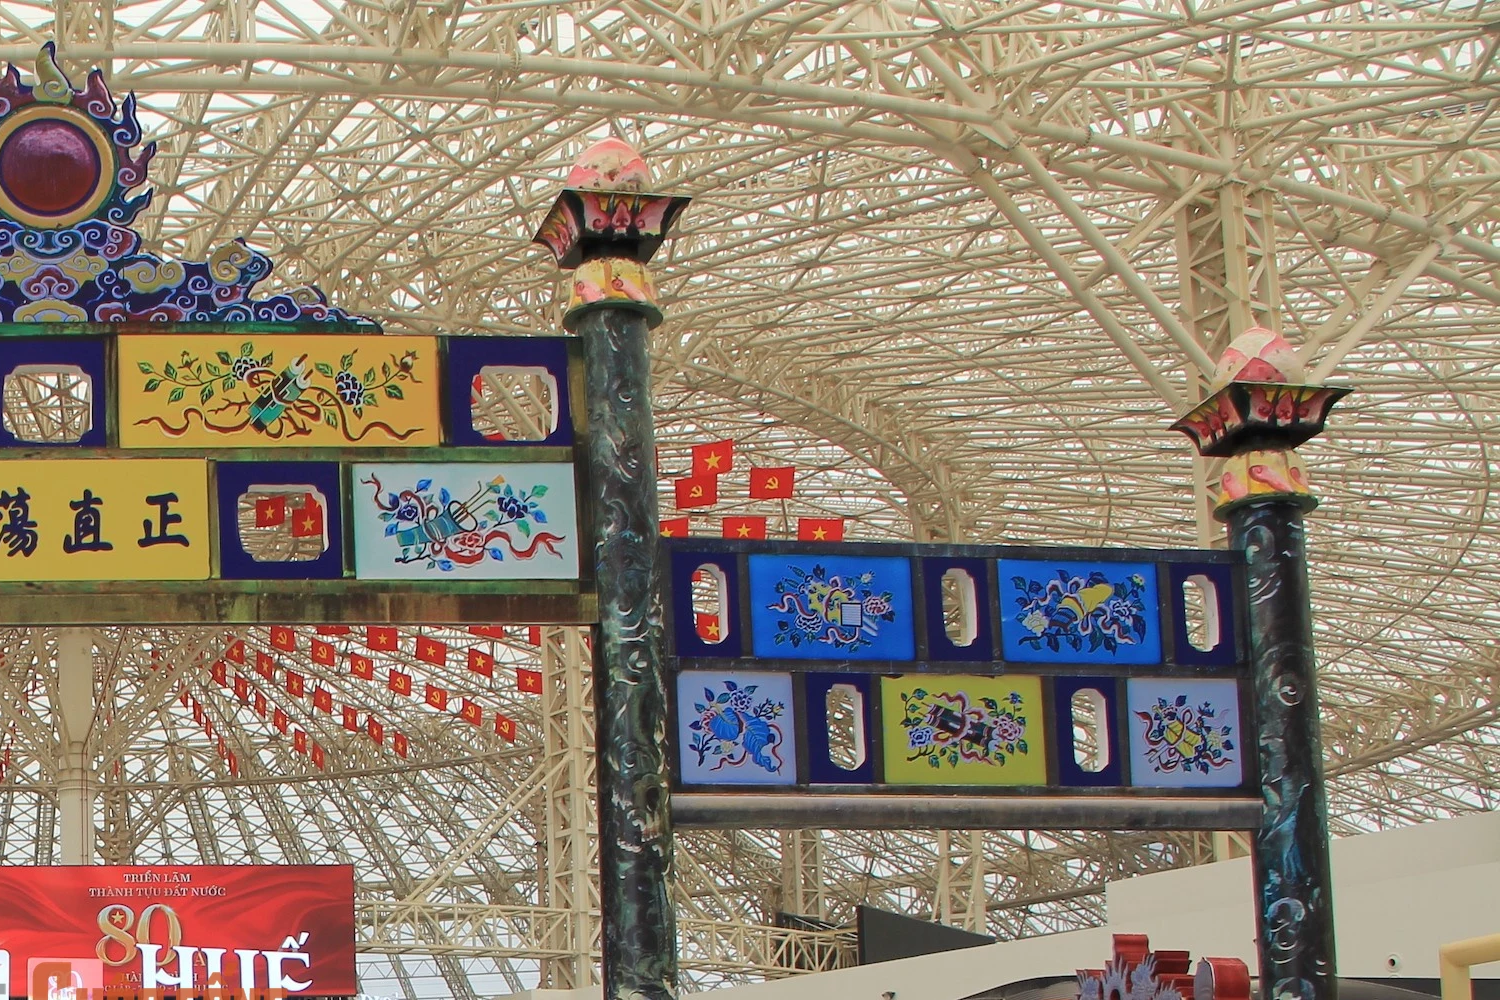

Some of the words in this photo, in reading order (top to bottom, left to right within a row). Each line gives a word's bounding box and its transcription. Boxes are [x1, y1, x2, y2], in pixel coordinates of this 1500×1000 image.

[123, 869, 161, 883] TRIỂN
[164, 872, 191, 883] LÃM
[89, 886, 134, 897] THÀNH
[136, 887, 162, 900] TỰU
[163, 885, 189, 897] ĐẤT
[192, 885, 226, 897] NƯỚC
[96, 904, 182, 966] 80
